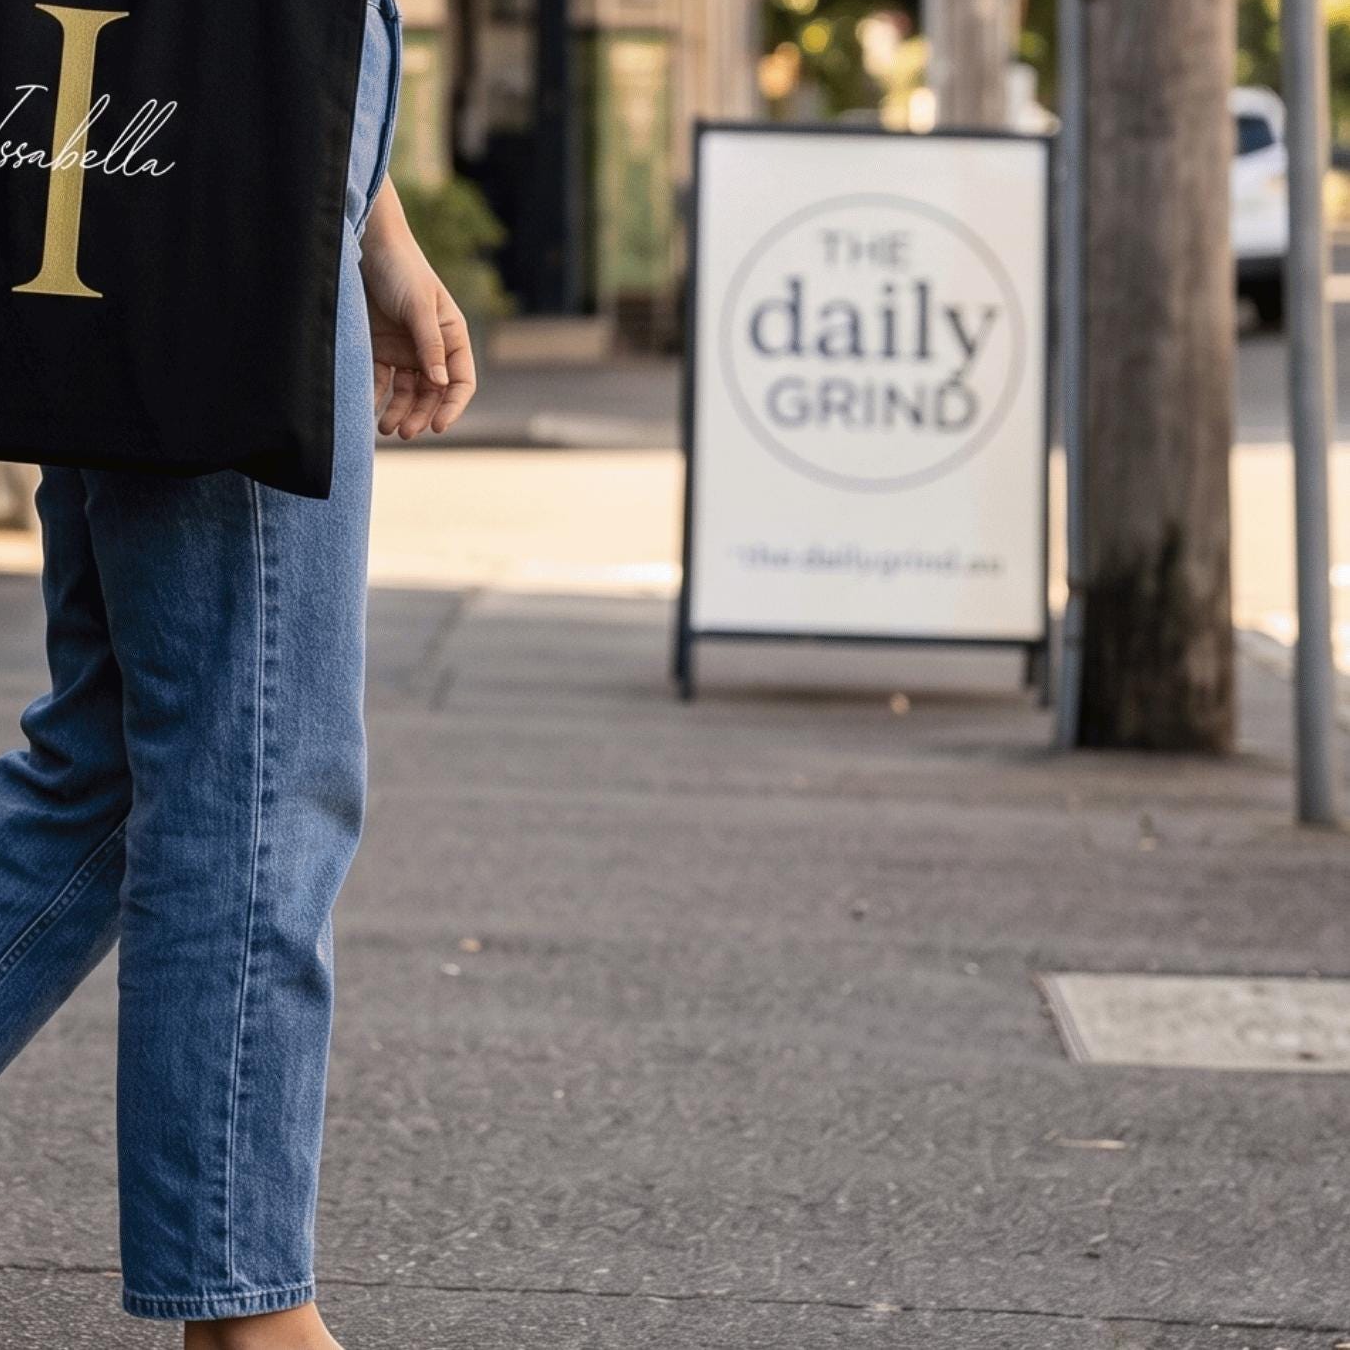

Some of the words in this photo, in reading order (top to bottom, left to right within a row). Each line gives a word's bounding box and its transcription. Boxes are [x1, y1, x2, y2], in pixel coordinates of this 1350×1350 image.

[11, 2, 130, 298] I
[820, 229, 911, 269] THE
[749, 274, 998, 387] daily
[765, 376, 981, 435] GRIND
